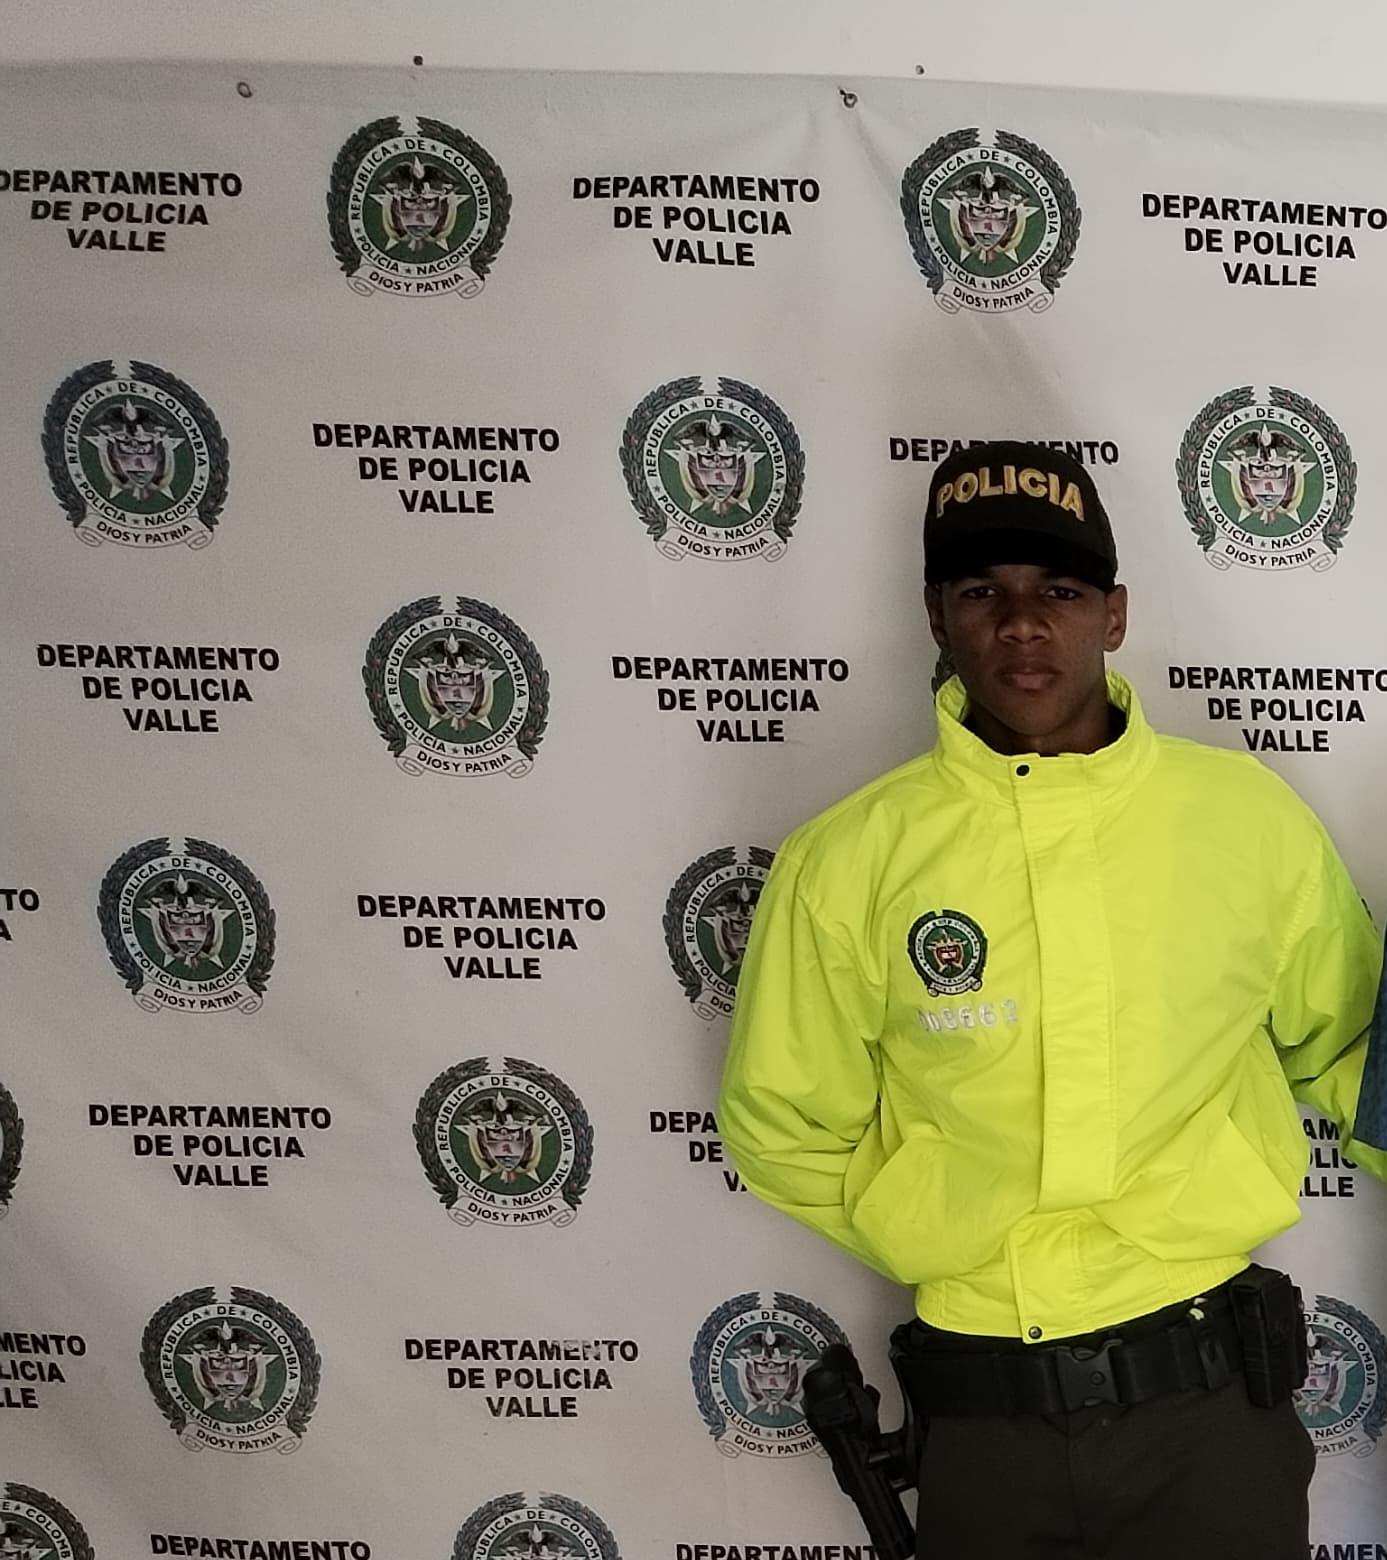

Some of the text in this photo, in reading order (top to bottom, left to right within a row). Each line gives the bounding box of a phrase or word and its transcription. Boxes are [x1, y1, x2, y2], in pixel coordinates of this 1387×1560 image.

[351, 138, 490, 222] REPUBLICA DE COLOMBIA
[572, 174, 820, 203] DEPARTAMENTO
[30, 199, 209, 226] DE POLICIA
[613, 205, 792, 236] DE POLICIA
[1142, 193, 1387, 230] DEPARTAMENTO
[66, 227, 167, 253] VALLE
[651, 237, 756, 267] VALLE
[1184, 227, 1356, 260] DE POLICIA
[356, 235, 482, 276] POLICIA NACIONAL
[368, 271, 401, 290] DIOS
[416, 272, 465, 294] PATRIA
[1222, 261, 1317, 287] VALLE
[312, 423, 560, 452] DEPARTAMENTO
[1200, 407, 1336, 491] REPUBLICA DE COLOMBIA
[358, 456, 532, 484] DE POLICIA
[398, 488, 495, 514] VALLE
[936, 464, 1086, 522] POLICIA
[1208, 505, 1332, 549] POLICIA NACIONAL
[1225, 544, 1256, 564] DIOS
[1271, 547, 1317, 567] PATRIA
[36, 643, 280, 672] DEPARTAMENTO
[611, 655, 849, 682] DEPARTAMENTO
[81, 675, 254, 702] DE POLICIA
[657, 687, 820, 712] DE POLICIA
[122, 707, 220, 733] VALLE
[1207, 697, 1366, 723] DE POLICIA
[696, 719, 785, 743] VALLE
[1241, 727, 1330, 753] VALLE
[357, 894, 606, 921] DEPARTAMENTO
[402, 925, 579, 951] DE POLICIA
[443, 956, 542, 980] VALLE
[88, 1103, 332, 1130] DEPARTAMENTO
[133, 1134, 306, 1158] DE POLICIA
[172, 1163, 269, 1187] VALLE
[447, 1367, 613, 1390] DE POLICIA
[485, 1396, 578, 1418] VALLE
